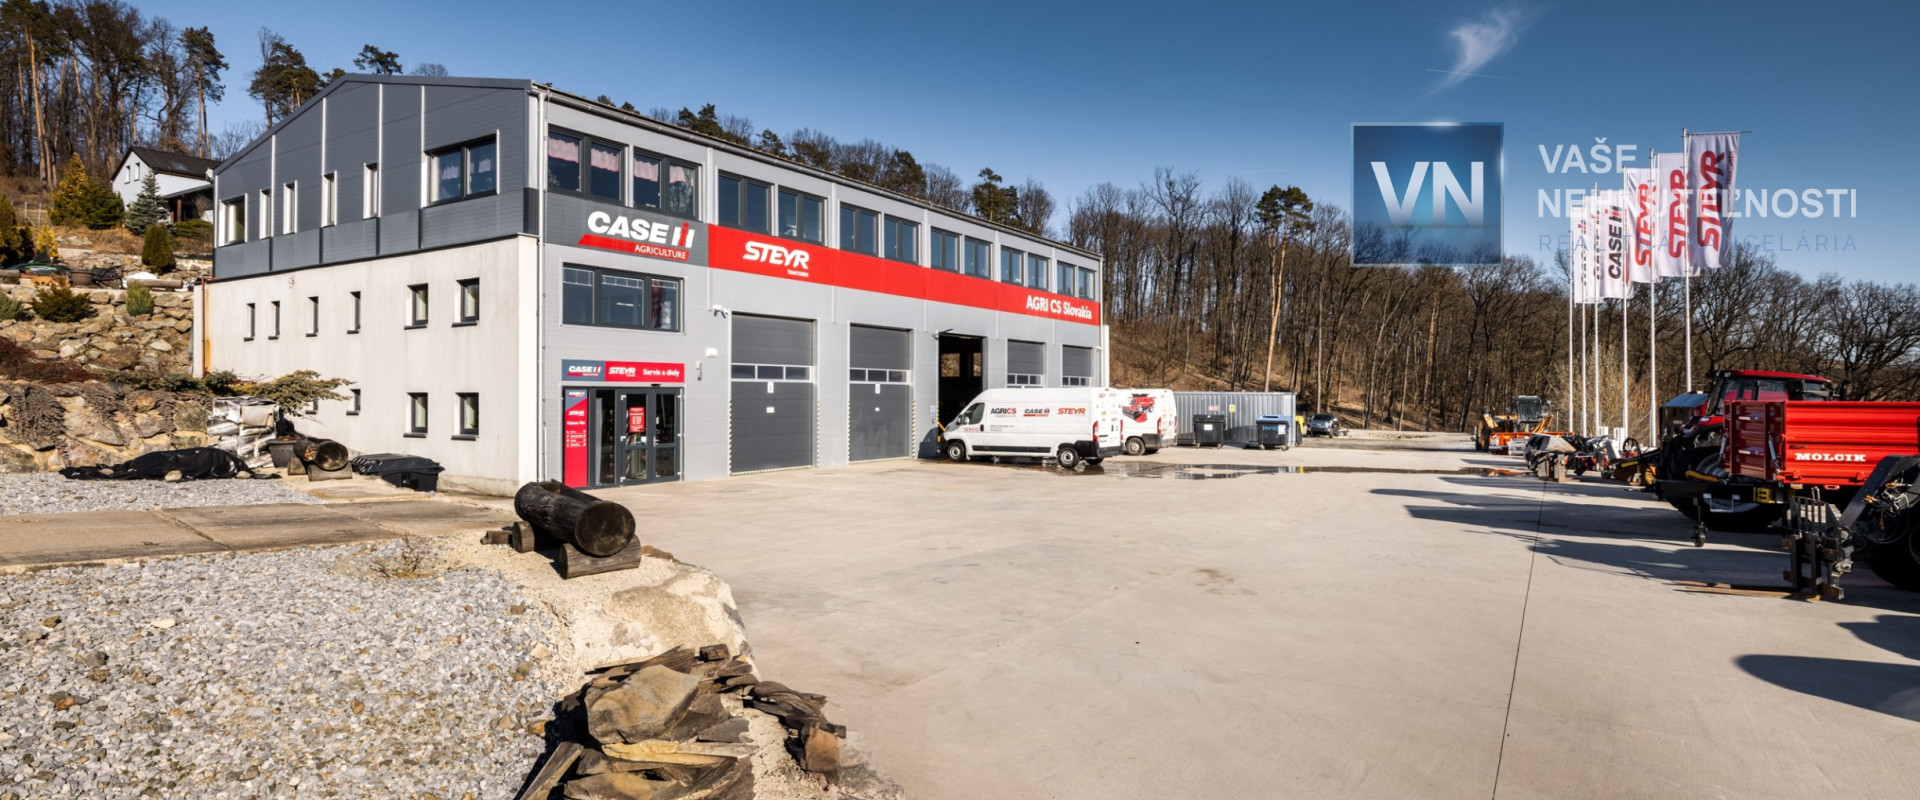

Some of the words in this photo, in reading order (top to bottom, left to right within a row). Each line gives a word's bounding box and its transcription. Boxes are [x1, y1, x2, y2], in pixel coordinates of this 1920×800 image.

[1697, 150, 1725, 252] STEYR
[587, 211, 668, 246] CASE
[634, 244, 687, 260] AGRICULTURE
[742, 240, 810, 270] STEYR
[1608, 224, 1622, 280] CASE
[1026, 294, 1049, 312] AGRI
[1050, 299, 1062, 314] CS
[1063, 301, 1093, 320] Slovakia
[568, 365, 593, 373] CASE
[608, 366, 636, 375] STEYR
[667, 368, 680, 377] diely
[1057, 407, 1086, 415] STEYR
[1794, 452, 1867, 462] MOLCIK
